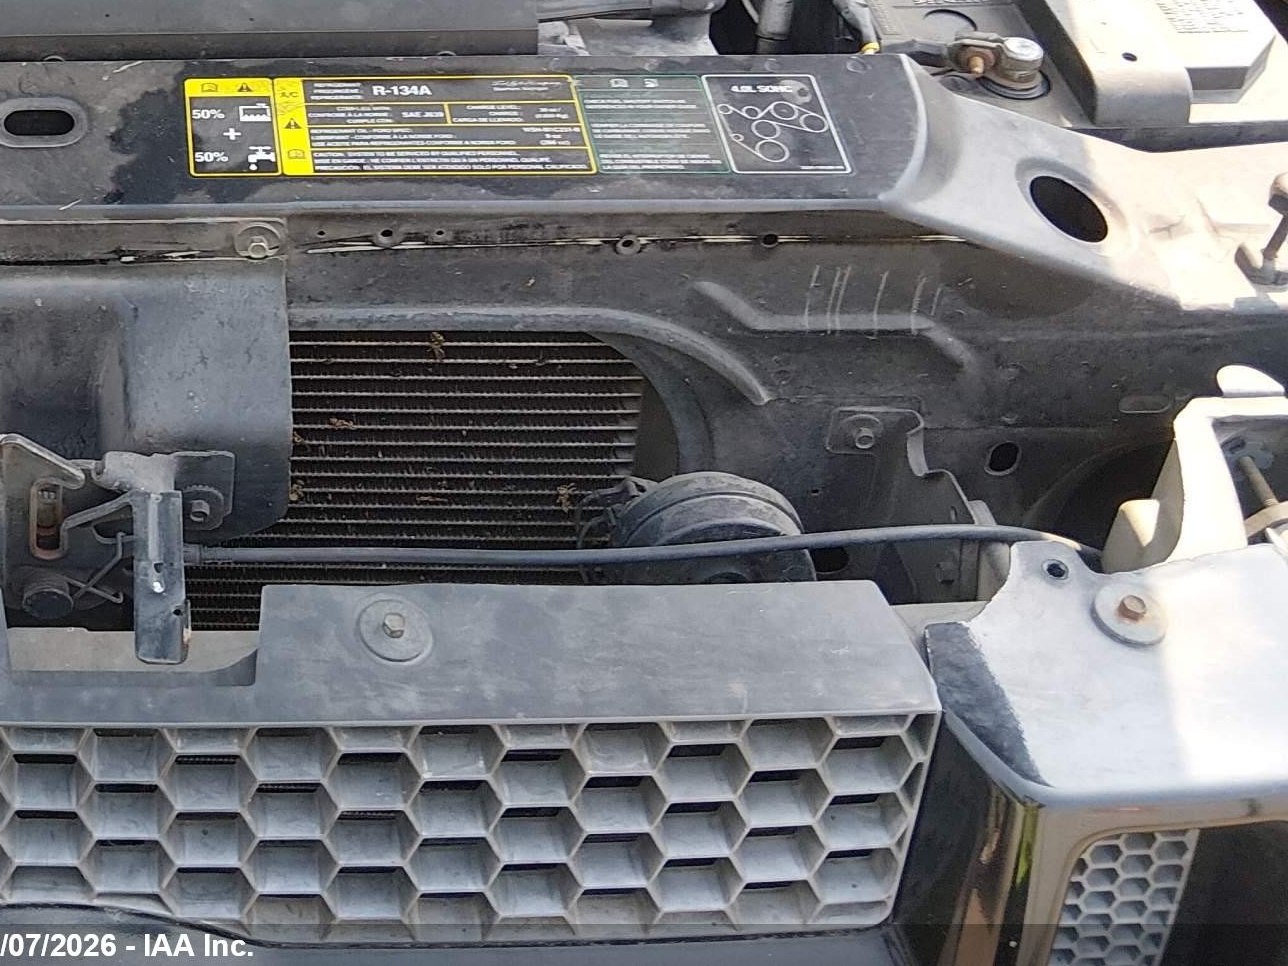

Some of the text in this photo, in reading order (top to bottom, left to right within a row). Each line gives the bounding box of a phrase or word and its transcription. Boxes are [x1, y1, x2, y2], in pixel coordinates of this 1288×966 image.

[372, 85, 432, 96] R-134A
[191, 109, 225, 120] 50%
[194, 151, 229, 163] 50%
